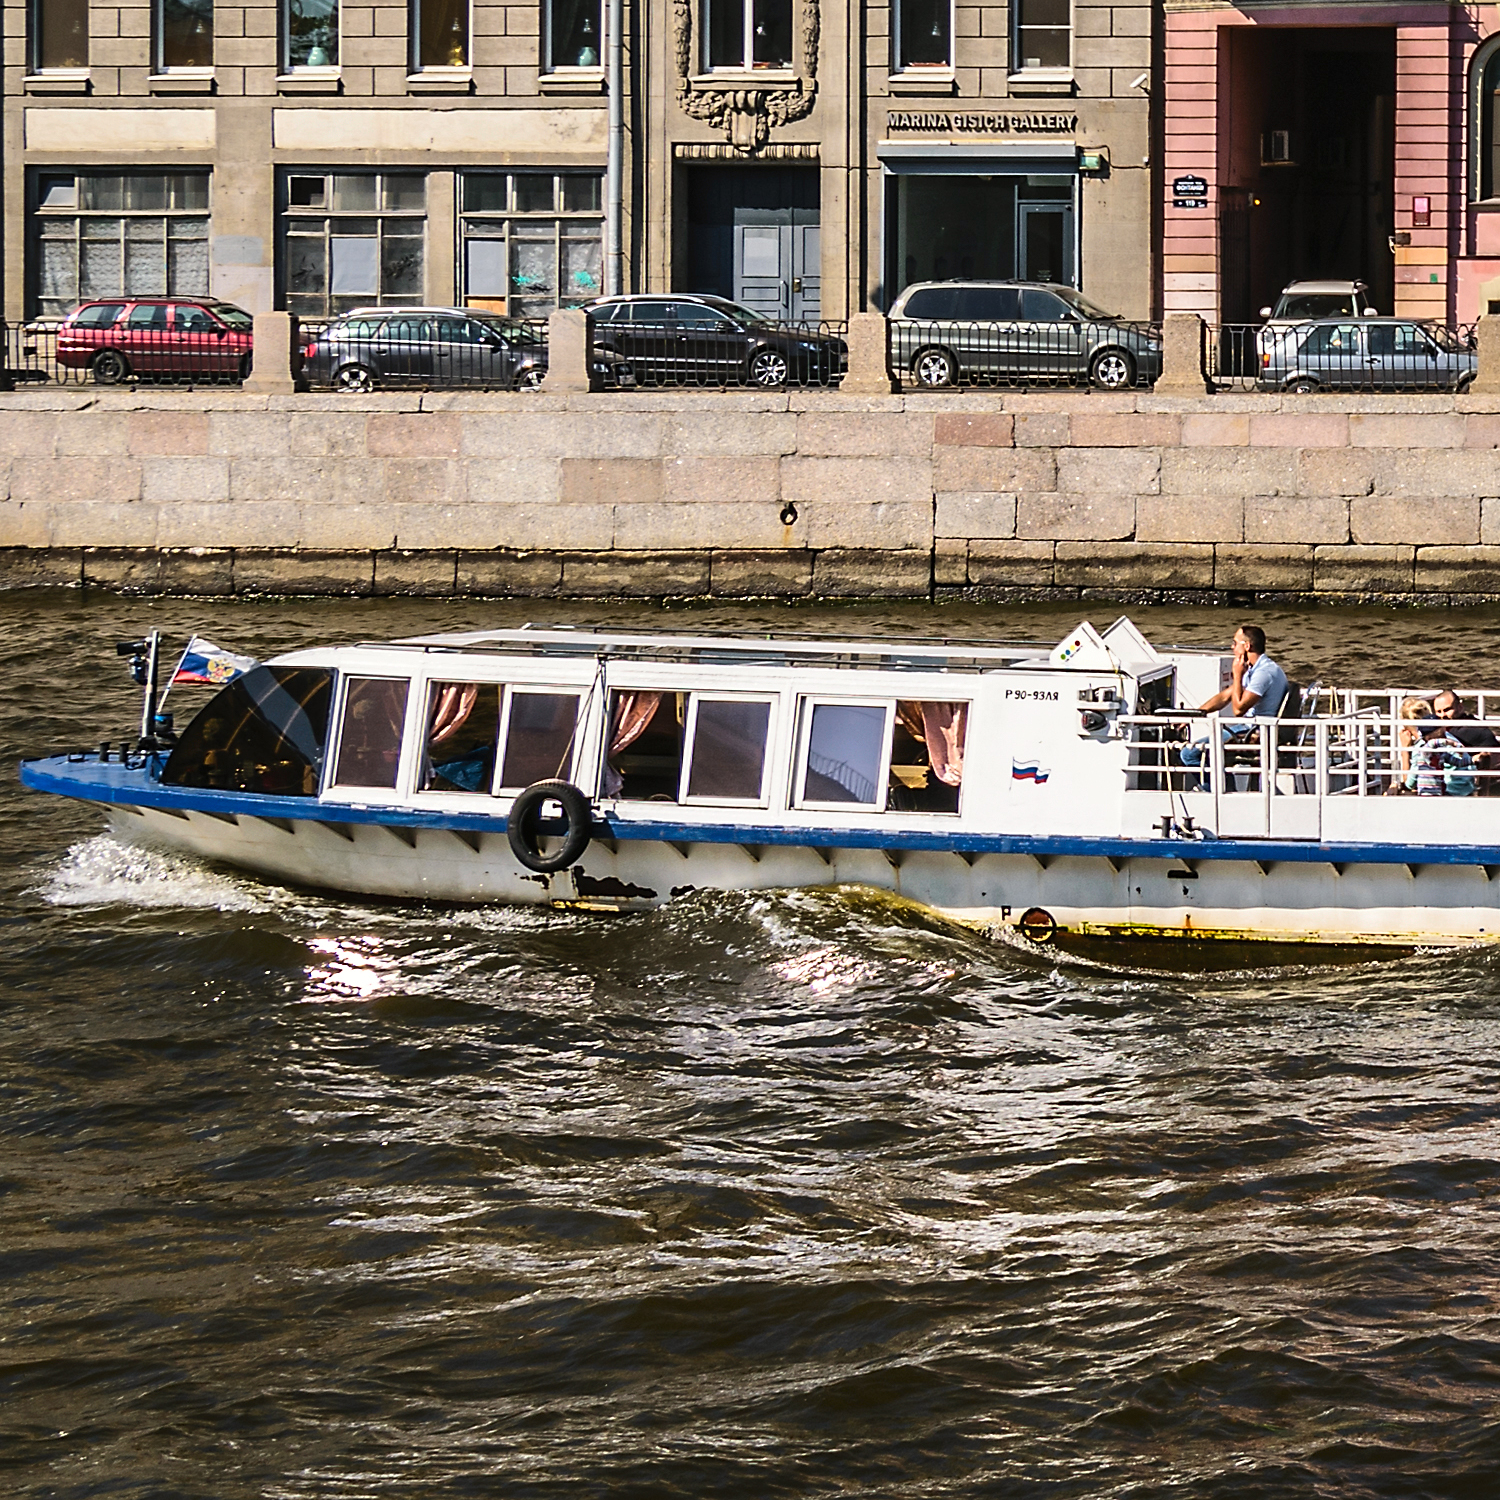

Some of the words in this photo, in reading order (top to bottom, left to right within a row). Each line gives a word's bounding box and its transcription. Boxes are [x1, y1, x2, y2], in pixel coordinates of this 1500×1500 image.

[887, 113, 949, 129] MARINA
[953, 114, 1006, 129] GISICH
[1008, 115, 1076, 130] GALLERY
